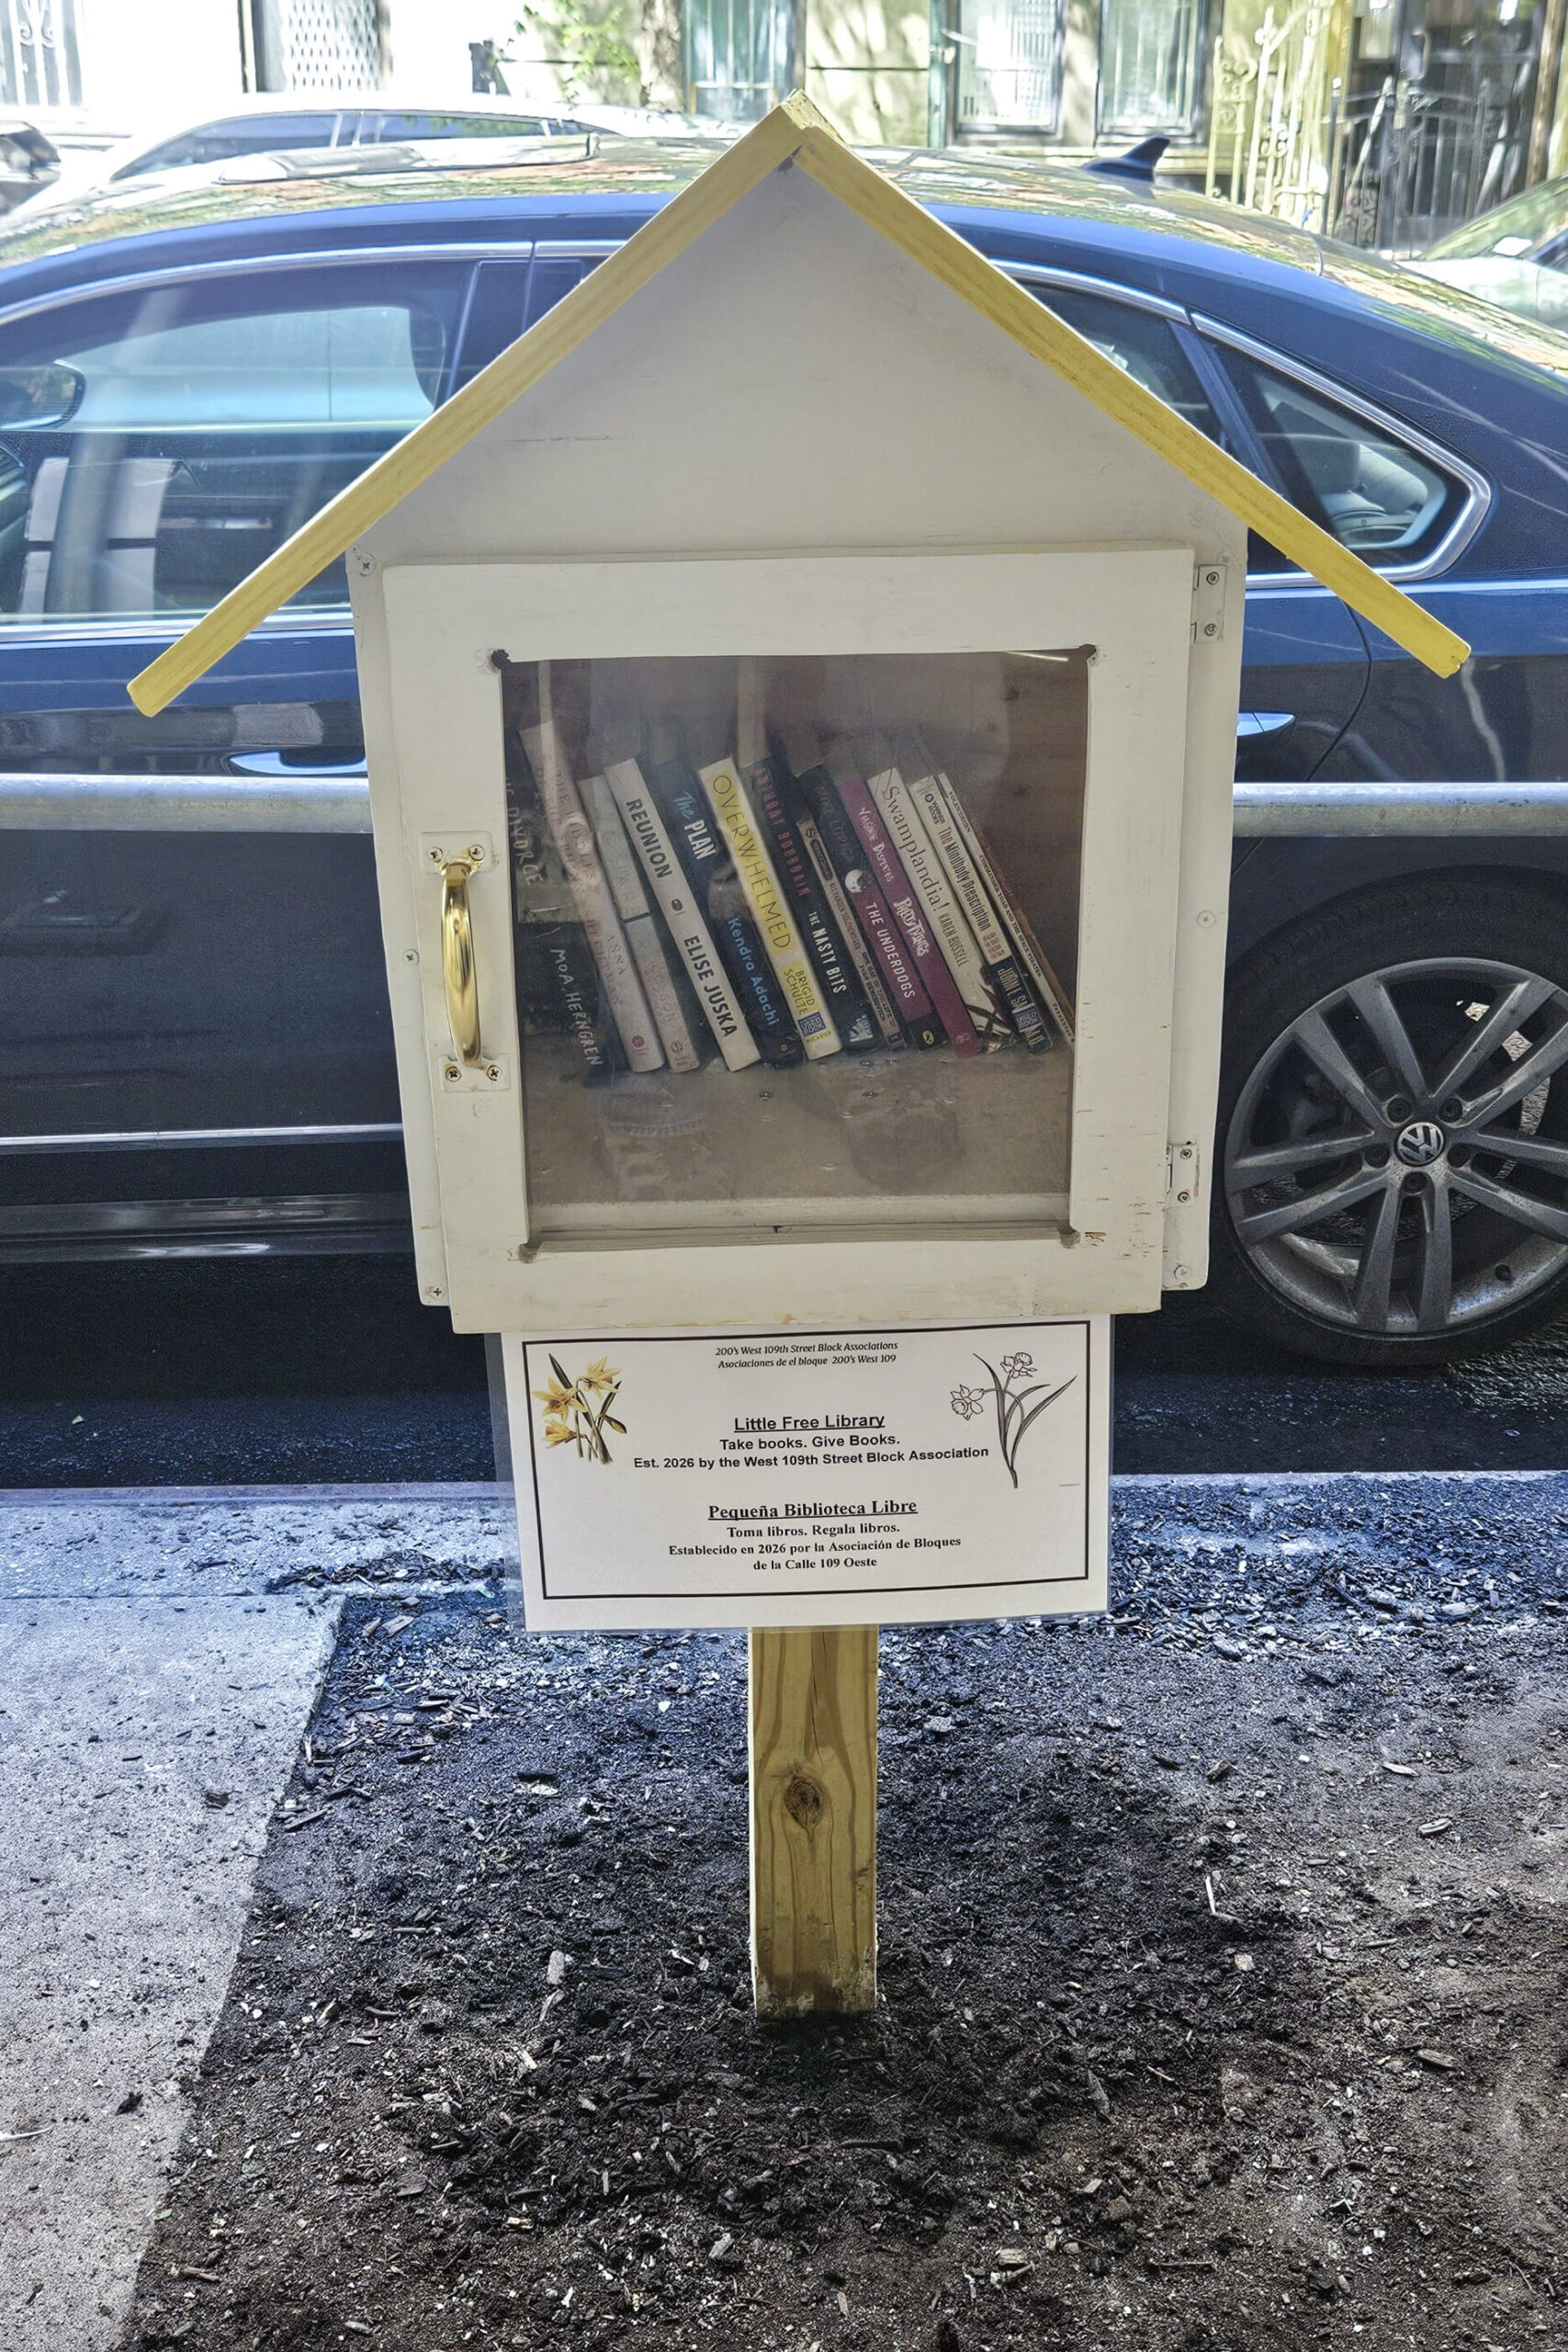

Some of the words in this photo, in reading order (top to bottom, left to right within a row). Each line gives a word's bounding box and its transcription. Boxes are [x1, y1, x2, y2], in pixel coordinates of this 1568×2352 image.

[673, 790, 696, 820] The
[507, 807, 544, 887] DIVORCE
[682, 818, 716, 860] PLAN
[882, 785, 950, 912] Swamplandia!
[936, 825, 955, 845] The
[712, 775, 793, 949] OVERWHELMED
[942, 840, 972, 884] Mindbody
[625, 796, 673, 879] REUNION
[682, 933, 715, 981] ELISE
[702, 980, 739, 1037] JUSKA
[807, 910, 820, 926] THE
[958, 879, 993, 933] Prescription
[936, 910, 959, 938] KAREN
[1005, 909, 1015, 922] AND
[1011, 921, 1021, 934] THE
[811, 926, 837, 966] NASTY
[864, 900, 884, 926] THE
[875, 926, 916, 1000] UNDERDOGS
[945, 933, 972, 967] RUSSELL
[726, 916, 758, 972] Kendra
[749, 973, 780, 1026] Adachi
[825, 965, 848, 995] BITS
[783, 967, 808, 1015] SCHULTE
[795, 968, 816, 1006] BRIGID
[565, 989, 604, 1068] HERNGREN
[714, 1346, 740, 1356] 200's
[739, 1345, 763, 1355] West
[763, 1344, 790, 1354] 109th
[789, 1343, 817, 1353] Street
[816, 1342, 843, 1352] Block
[841, 1340, 899, 1351] Associations
[716, 1358, 775, 1369] Asociaciones
[774, 1358, 788, 1367] de
[787, 1356, 798, 1365] el
[796, 1355, 829, 1367] bloque
[830, 1355, 857, 1365] 200's
[856, 1354, 879, 1364] West
[879, 1353, 897, 1363] 109
[734, 1416, 777, 1430] Little
[782, 1415, 820, 1430] Free
[825, 1413, 886, 1430] Library
[719, 1438, 754, 1451] Take
[758, 1437, 807, 1450] books.
[811, 1434, 845, 1447] Give
[849, 1433, 900, 1446] Books.
[633, 1457, 660, 1468] Est.
[662, 1456, 695, 1468] 2026
[698, 1457, 716, 1471] by
[718, 1456, 740, 1468] the
[743, 1455, 779, 1468] West
[782, 1453, 818, 1465] 109th
[822, 1453, 863, 1464] Street
[866, 1451, 906, 1464] Block
[908, 1446, 989, 1461] Association
[708, 1504, 779, 1521] Pequeña
[784, 1501, 867, 1517] Biblioteca
[870, 1499, 919, 1515] Libre
[726, 1525, 763, 1538] Toma
[767, 1524, 807, 1537] libros.
[812, 1523, 856, 1538] Regala
[860, 1522, 900, 1534] libros.
[669, 1543, 738, 1556] Establecido
[758, 1544, 786, 1555] 2026
[789, 1545, 811, 1555] por
[814, 1542, 825, 1553] la
[829, 1539, 893, 1552] Asociación
[896, 1539, 910, 1549] de
[914, 1537, 962, 1550] Bloques
[752, 1560, 768, 1569] de
[771, 1560, 782, 1570] la
[784, 1559, 817, 1569] Calle
[820, 1558, 840, 1568] 109
[843, 1557, 877, 1568] Oeste
